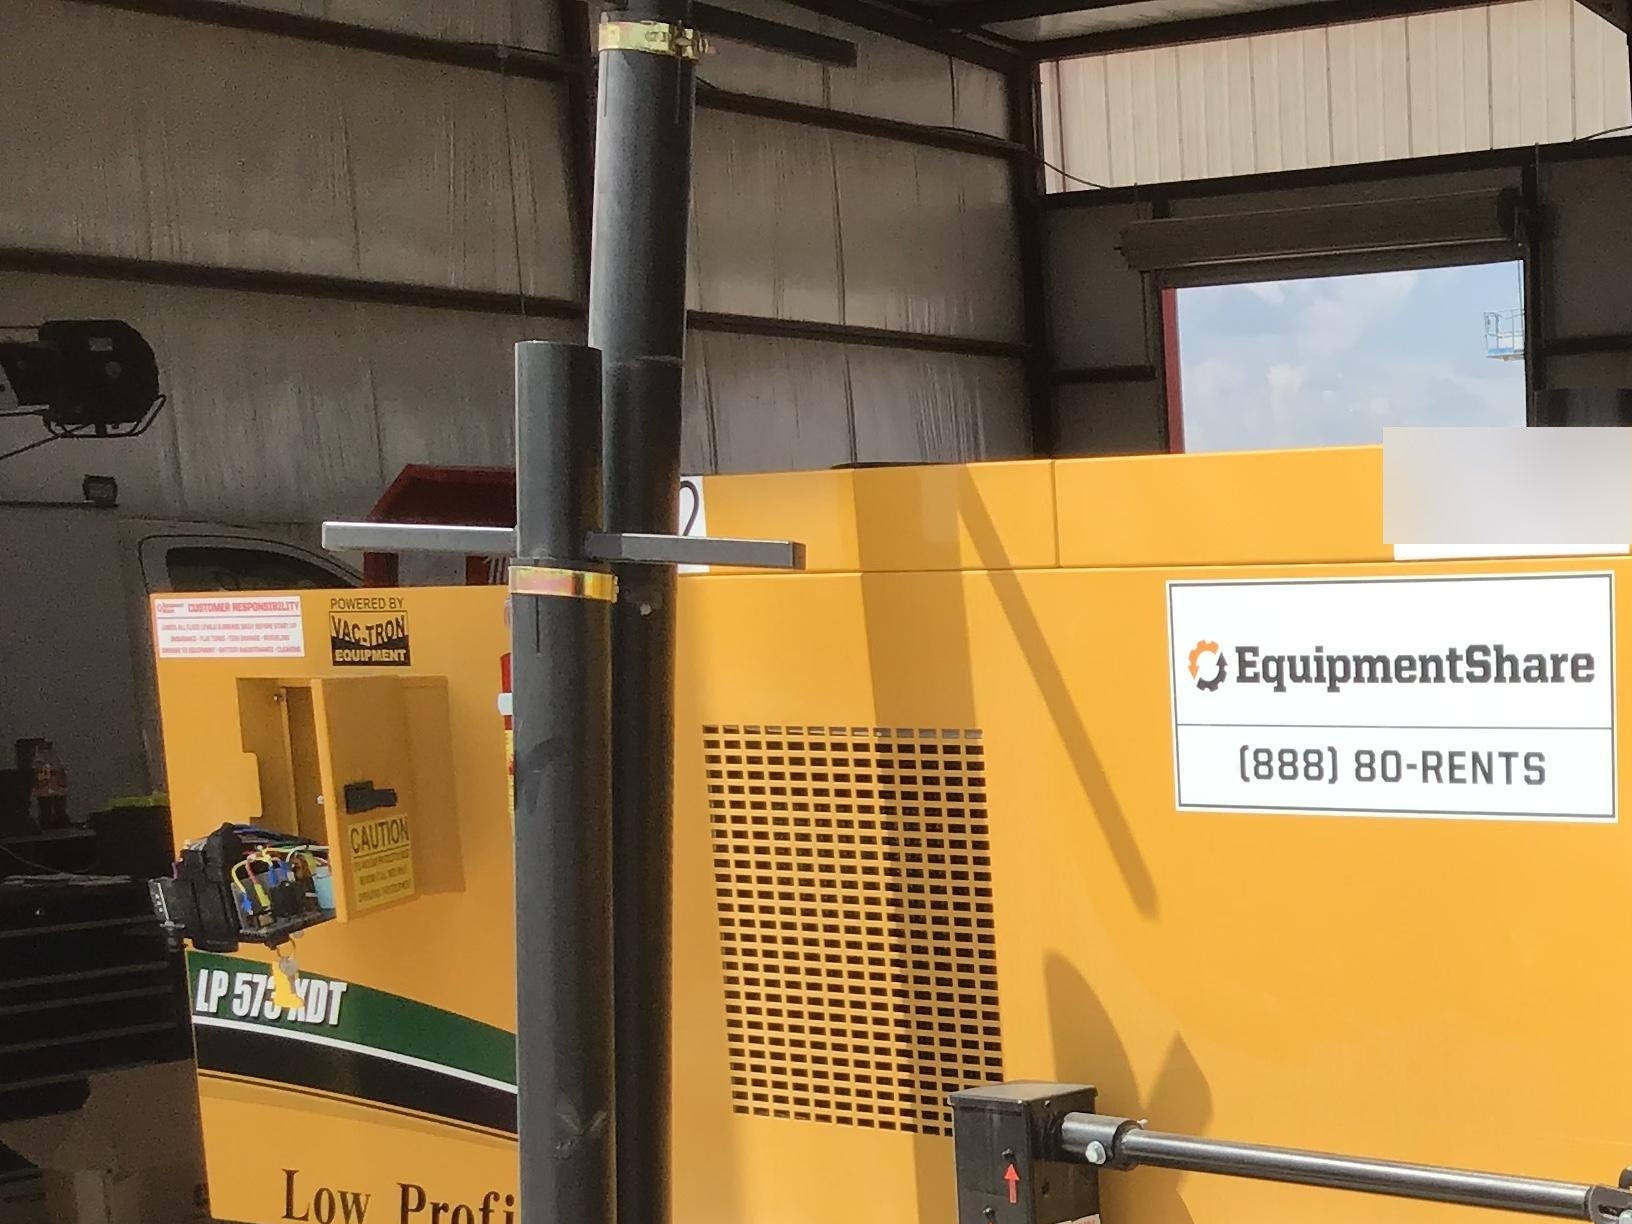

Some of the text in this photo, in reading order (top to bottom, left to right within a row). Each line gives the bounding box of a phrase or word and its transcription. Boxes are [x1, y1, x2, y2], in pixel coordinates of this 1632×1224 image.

[330, 597, 404, 610] POWERED BY
[335, 649, 406, 662] EQUIPMENT
[1235, 644, 1594, 692] EquipmentShare
[1240, 745, 1546, 785] (888) 80-RENTS
[351, 816, 408, 853] CAUTION
[195, 968, 229, 1014] LP
